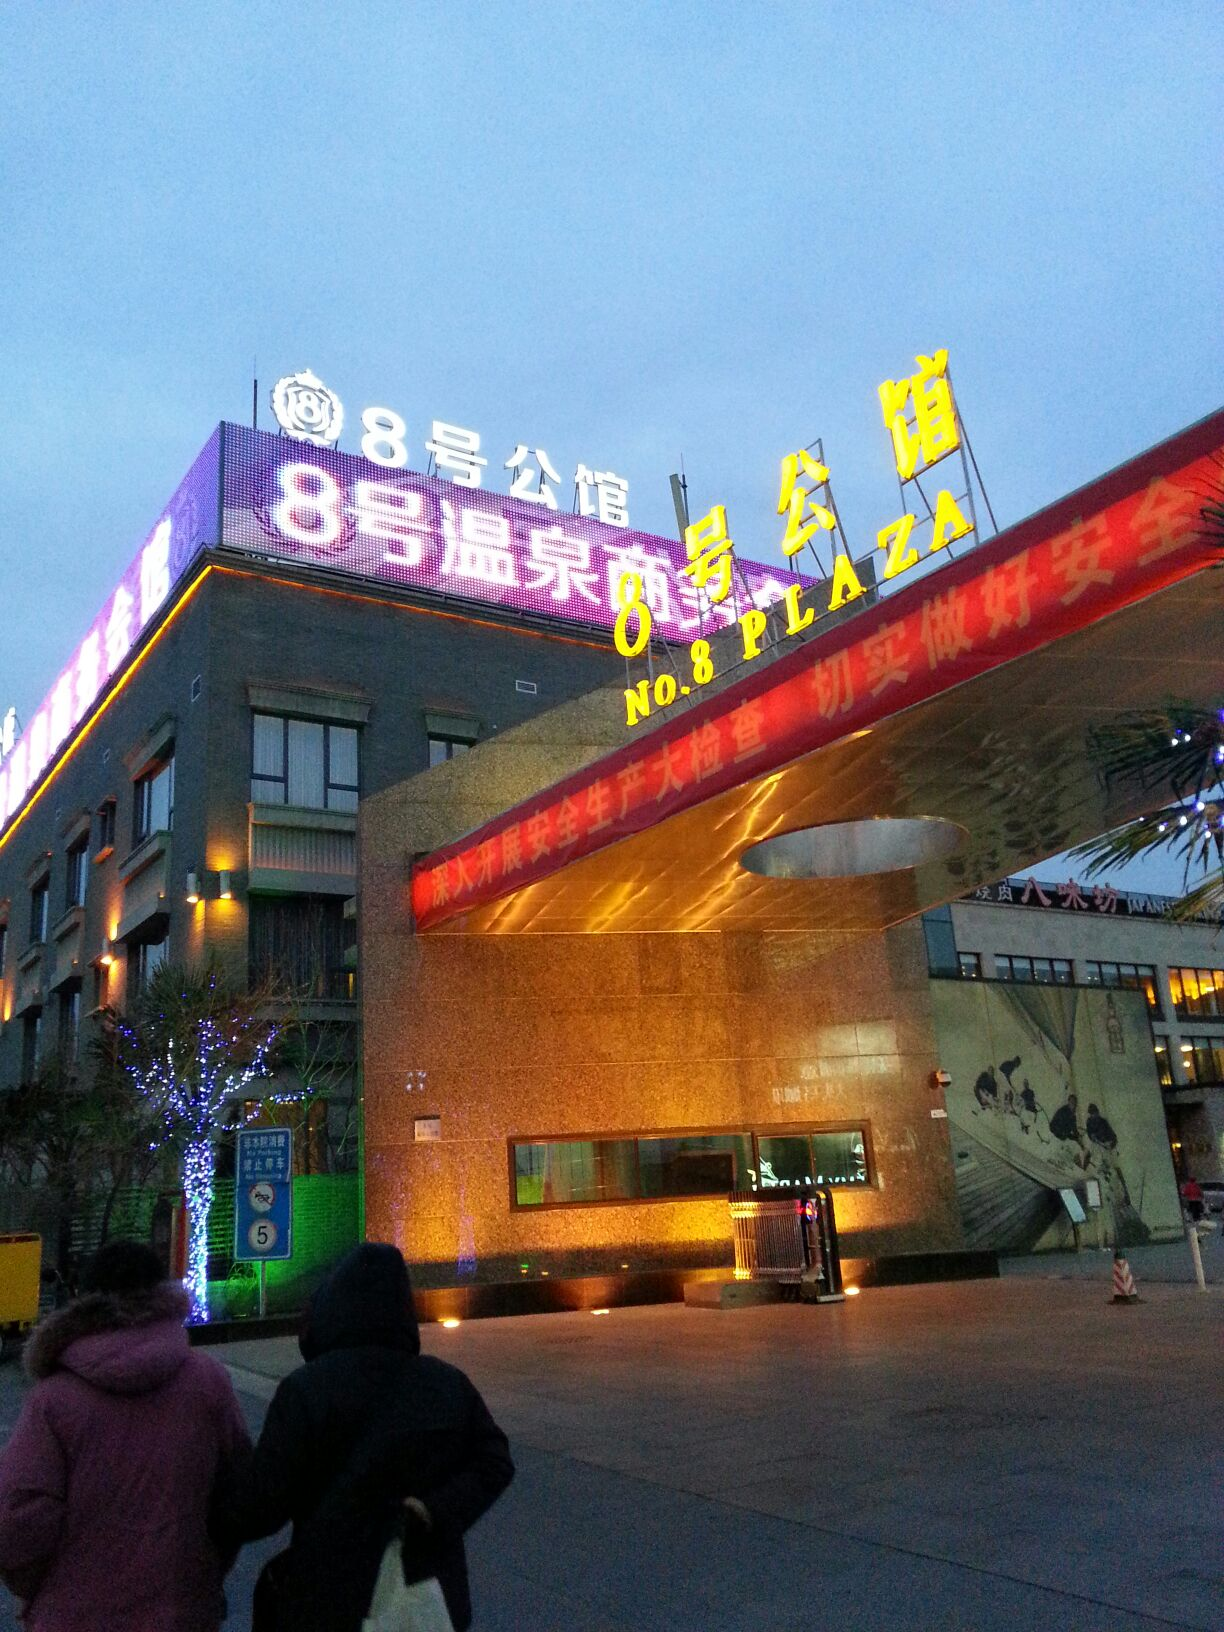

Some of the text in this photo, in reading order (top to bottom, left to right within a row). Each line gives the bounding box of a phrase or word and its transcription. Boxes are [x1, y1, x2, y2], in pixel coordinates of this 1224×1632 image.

[360, 406, 630, 529] 8号公馆
[613, 348, 961, 658] 8号公馆
[738, 489, 975, 660] PLAZA
[432, 699, 767, 909] 深入开展安全生产大检查
[1021, 876, 1120, 913] 八味坊
[243, 1157, 286, 1171] 禁止停车
[257, 1226, 268, 1245] 5
